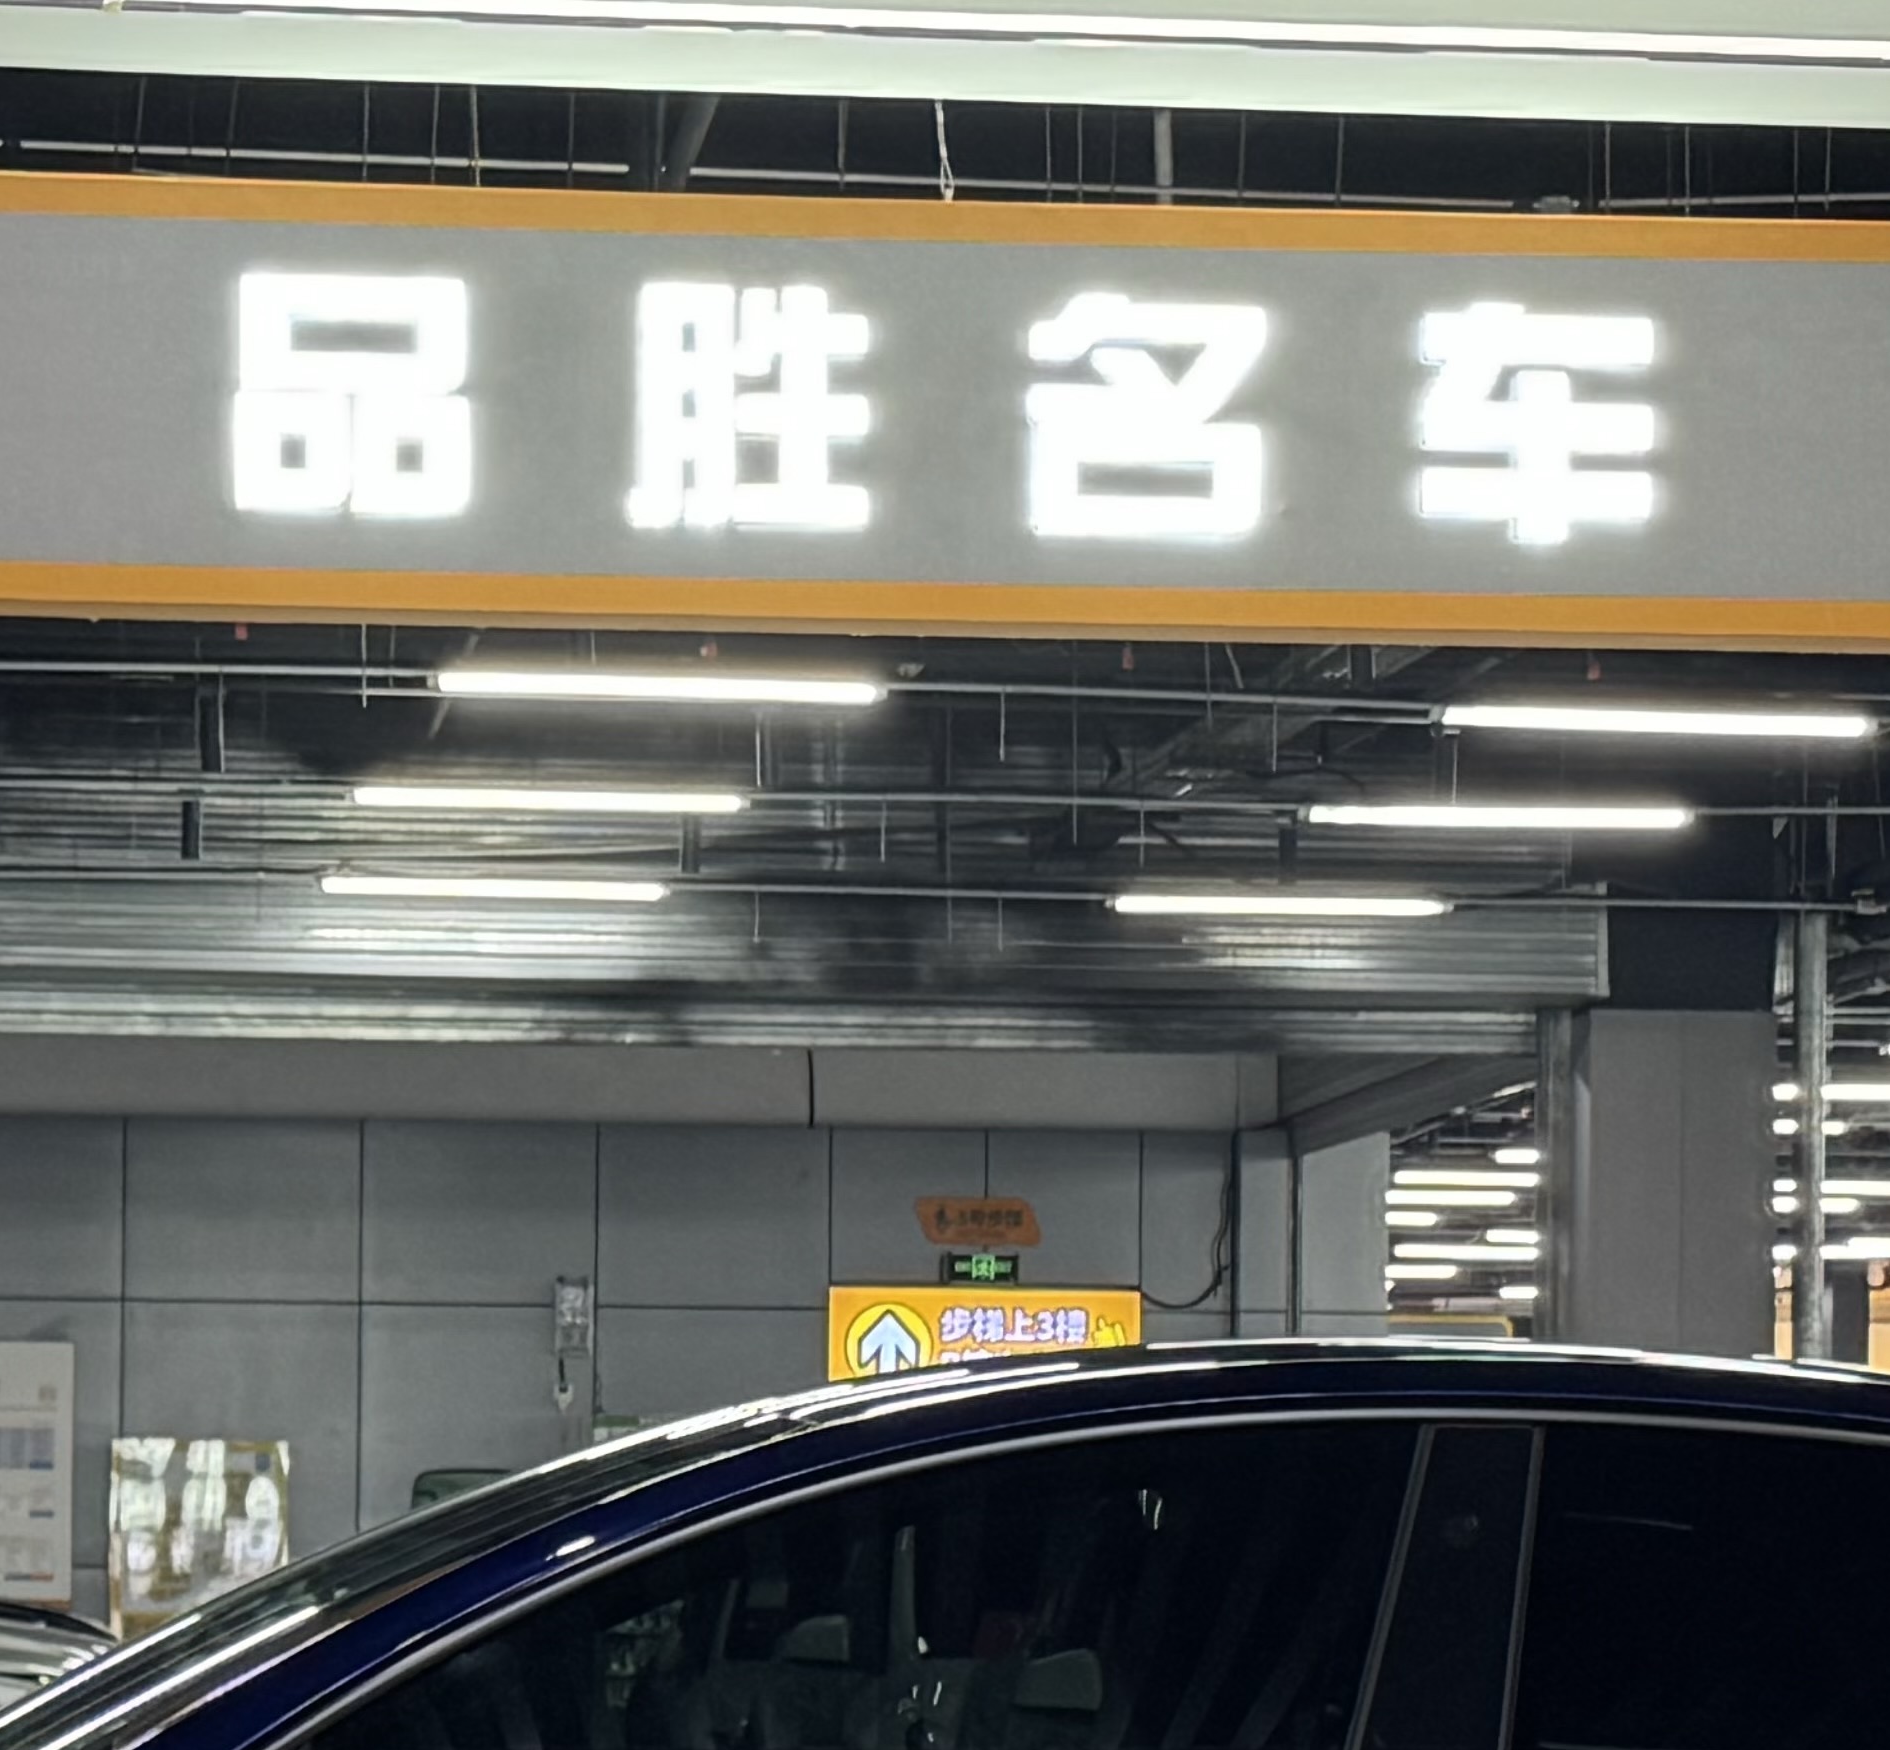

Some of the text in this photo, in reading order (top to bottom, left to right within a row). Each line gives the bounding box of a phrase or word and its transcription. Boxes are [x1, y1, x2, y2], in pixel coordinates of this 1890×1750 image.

[229, 268, 1660, 546] 品胜名车
[941, 1307, 1088, 1344] 步梯上3楼
